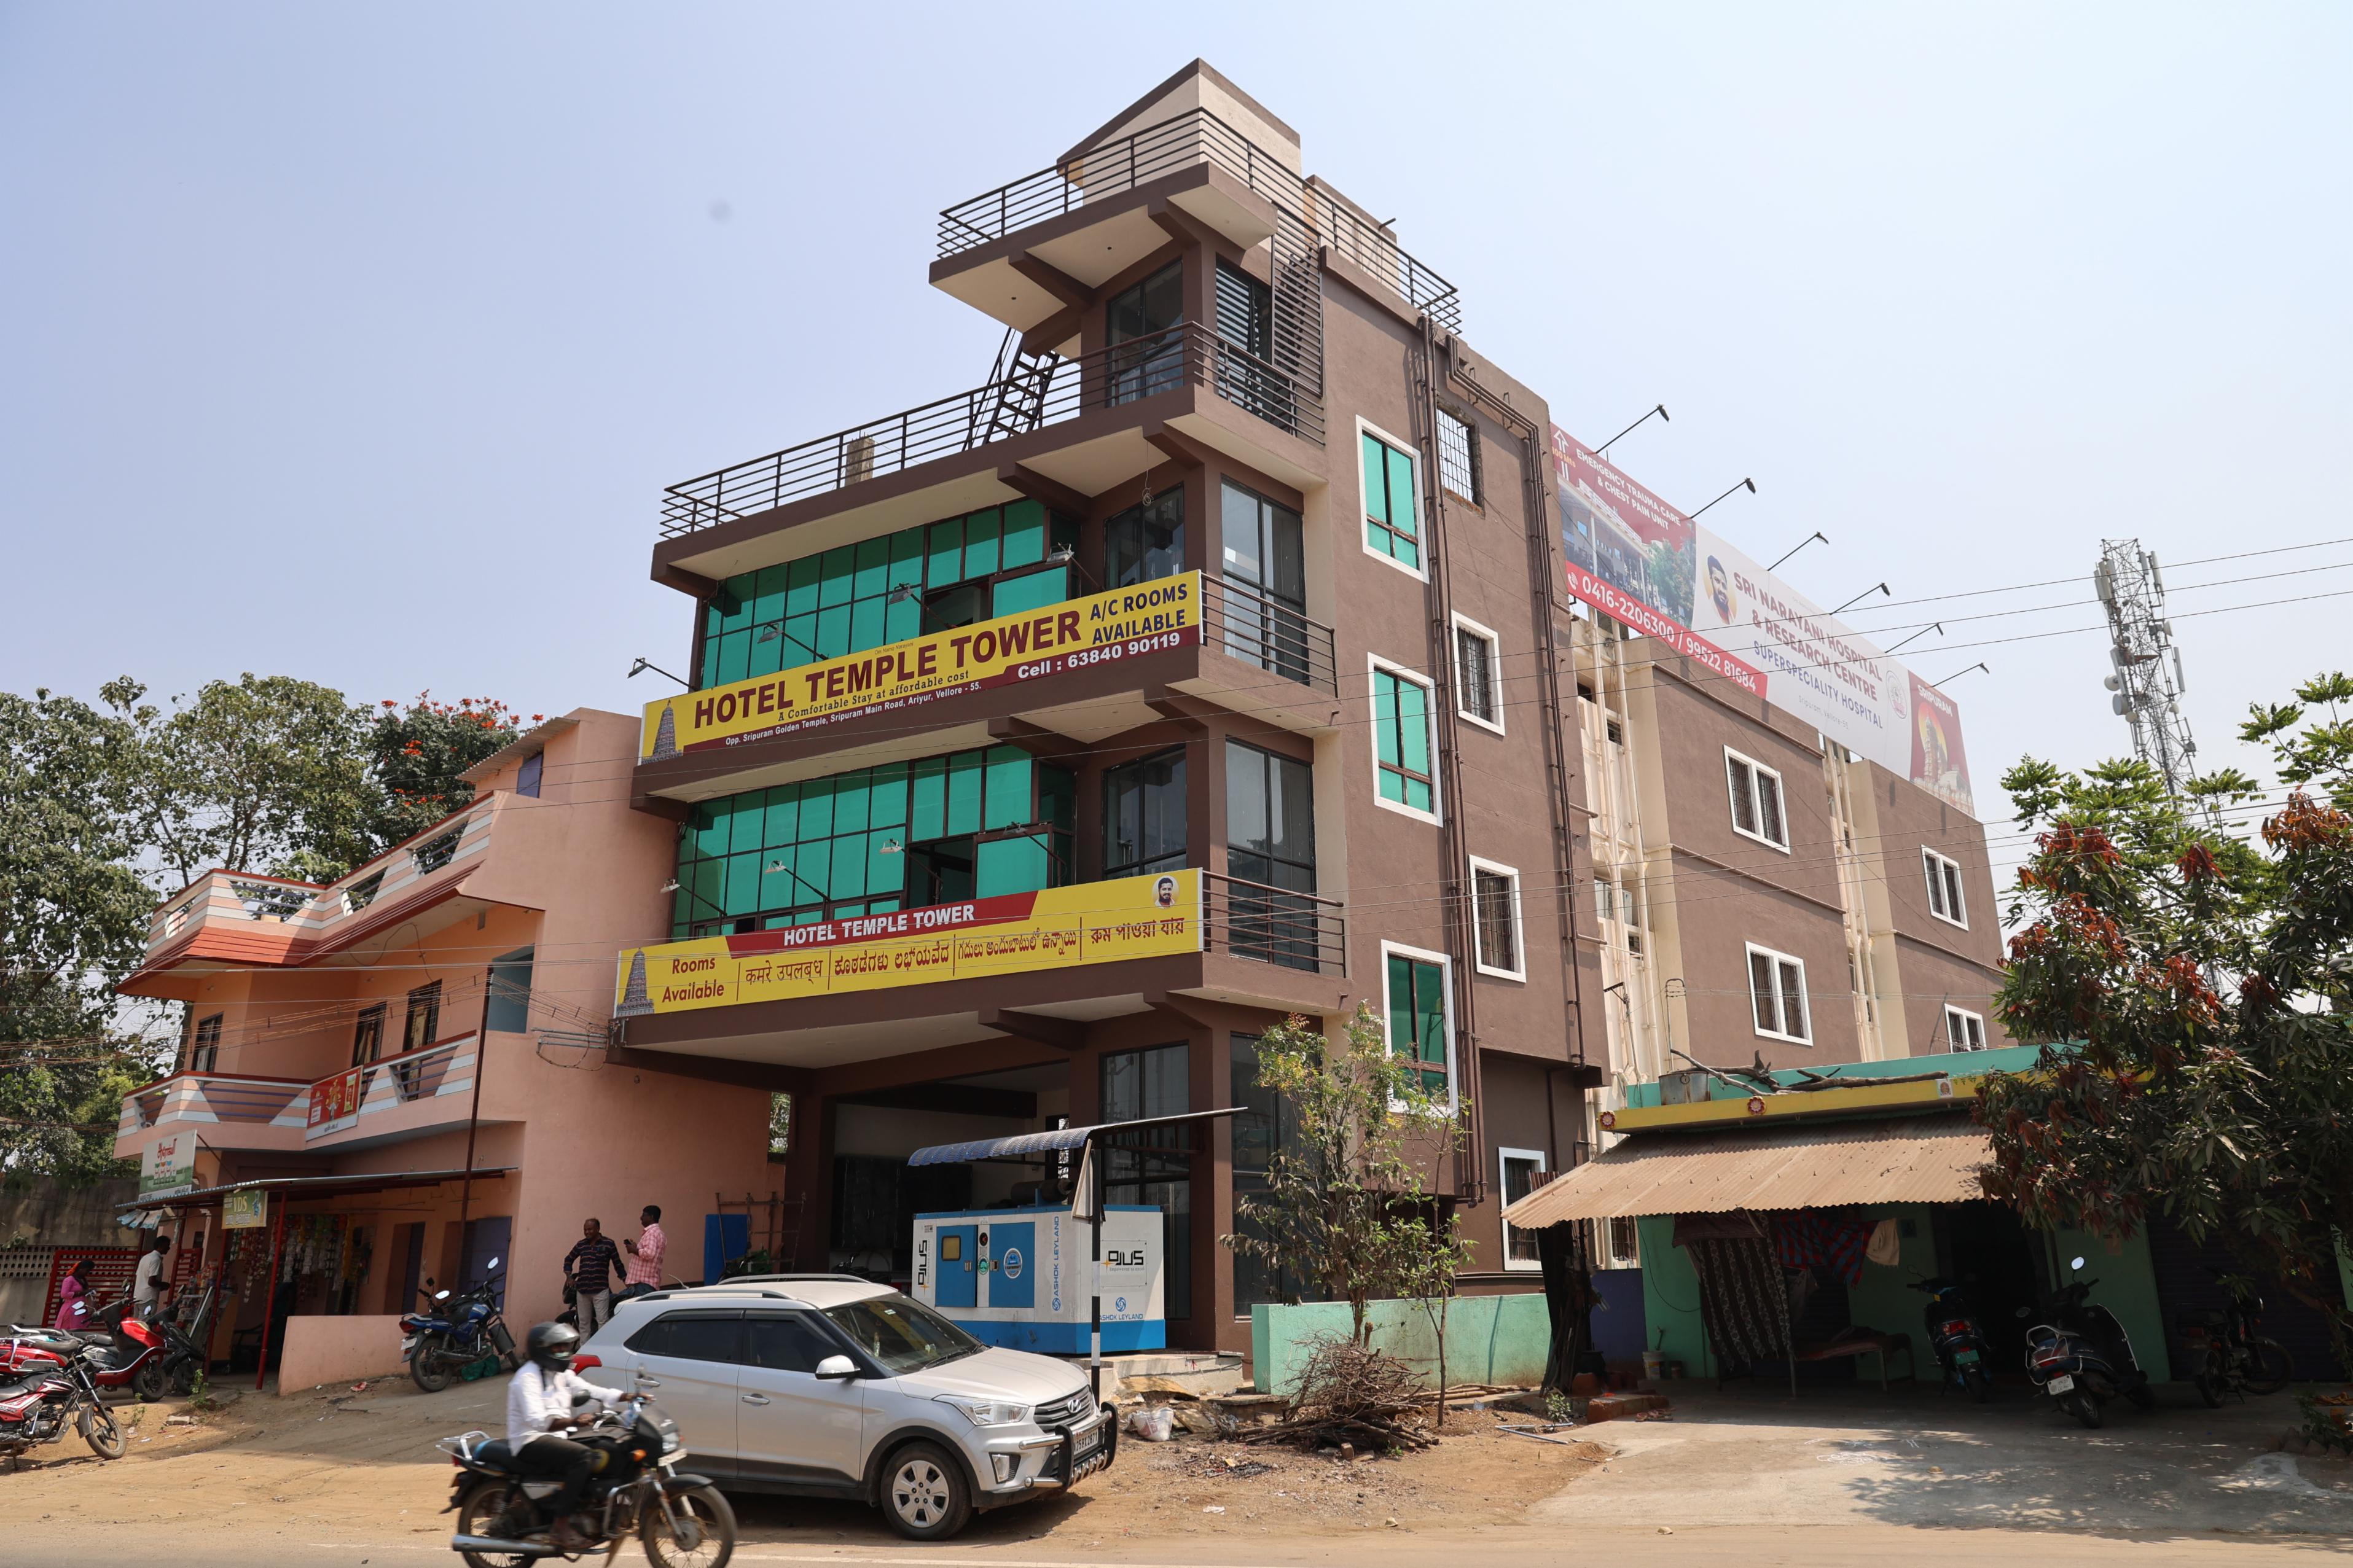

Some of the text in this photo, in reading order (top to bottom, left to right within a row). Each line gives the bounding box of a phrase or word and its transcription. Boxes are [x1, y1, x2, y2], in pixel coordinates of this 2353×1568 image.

[1576, 448, 1681, 526] EMERGENCY TRAUMA CARE
[1597, 476, 1669, 530] & CHEST PAIN UNIT
[1090, 583, 1188, 622] A/C ROOMS
[1092, 609, 1186, 645] AVAILABLE
[1734, 572, 1756, 601] SRI
[1759, 588, 1825, 645] NARAYANI
[1826, 633, 1882, 682] HOSPITAL
[1018, 660, 1050, 679] Cell
[1068, 645, 1122, 668] 63840
[1129, 632, 1180, 655] 90119
[1582, 576, 1675, 642] 0416-2206300
[1686, 638, 1721, 671] 99522
[1724, 660, 1756, 692] 81684
[1752, 609, 1877, 701] & RESEARCH CENTRE
[695, 610, 1081, 729] HOTEL TEMPLE TOWER
[1753, 640, 1883, 729] SUPERSPECIALITY HOSPITAL
[743, 729, 773, 742] Sripuram
[775, 723, 799, 735] Golden
[802, 717, 828, 728] Temple,
[831, 709, 863, 722] Sripuram
[865, 704, 882, 714] Main
[885, 700, 906, 710] Road,
[908, 694, 933, 705] Ariyur,
[936, 687, 962, 699] Vellore
[970, 682, 982, 691] 55.
[778, 670, 969, 722] A Comfortable Stay at affordable cost
[1917, 684, 1953, 717] SRIPURAM
[783, 904, 974, 946] HOTEL TEMPLE TOWER
[672, 958, 715, 974] Rooms
[746, 960, 772, 985] कमरे
[662, 979, 724, 1003] Available
[233, 1196, 248, 1212] VDS
